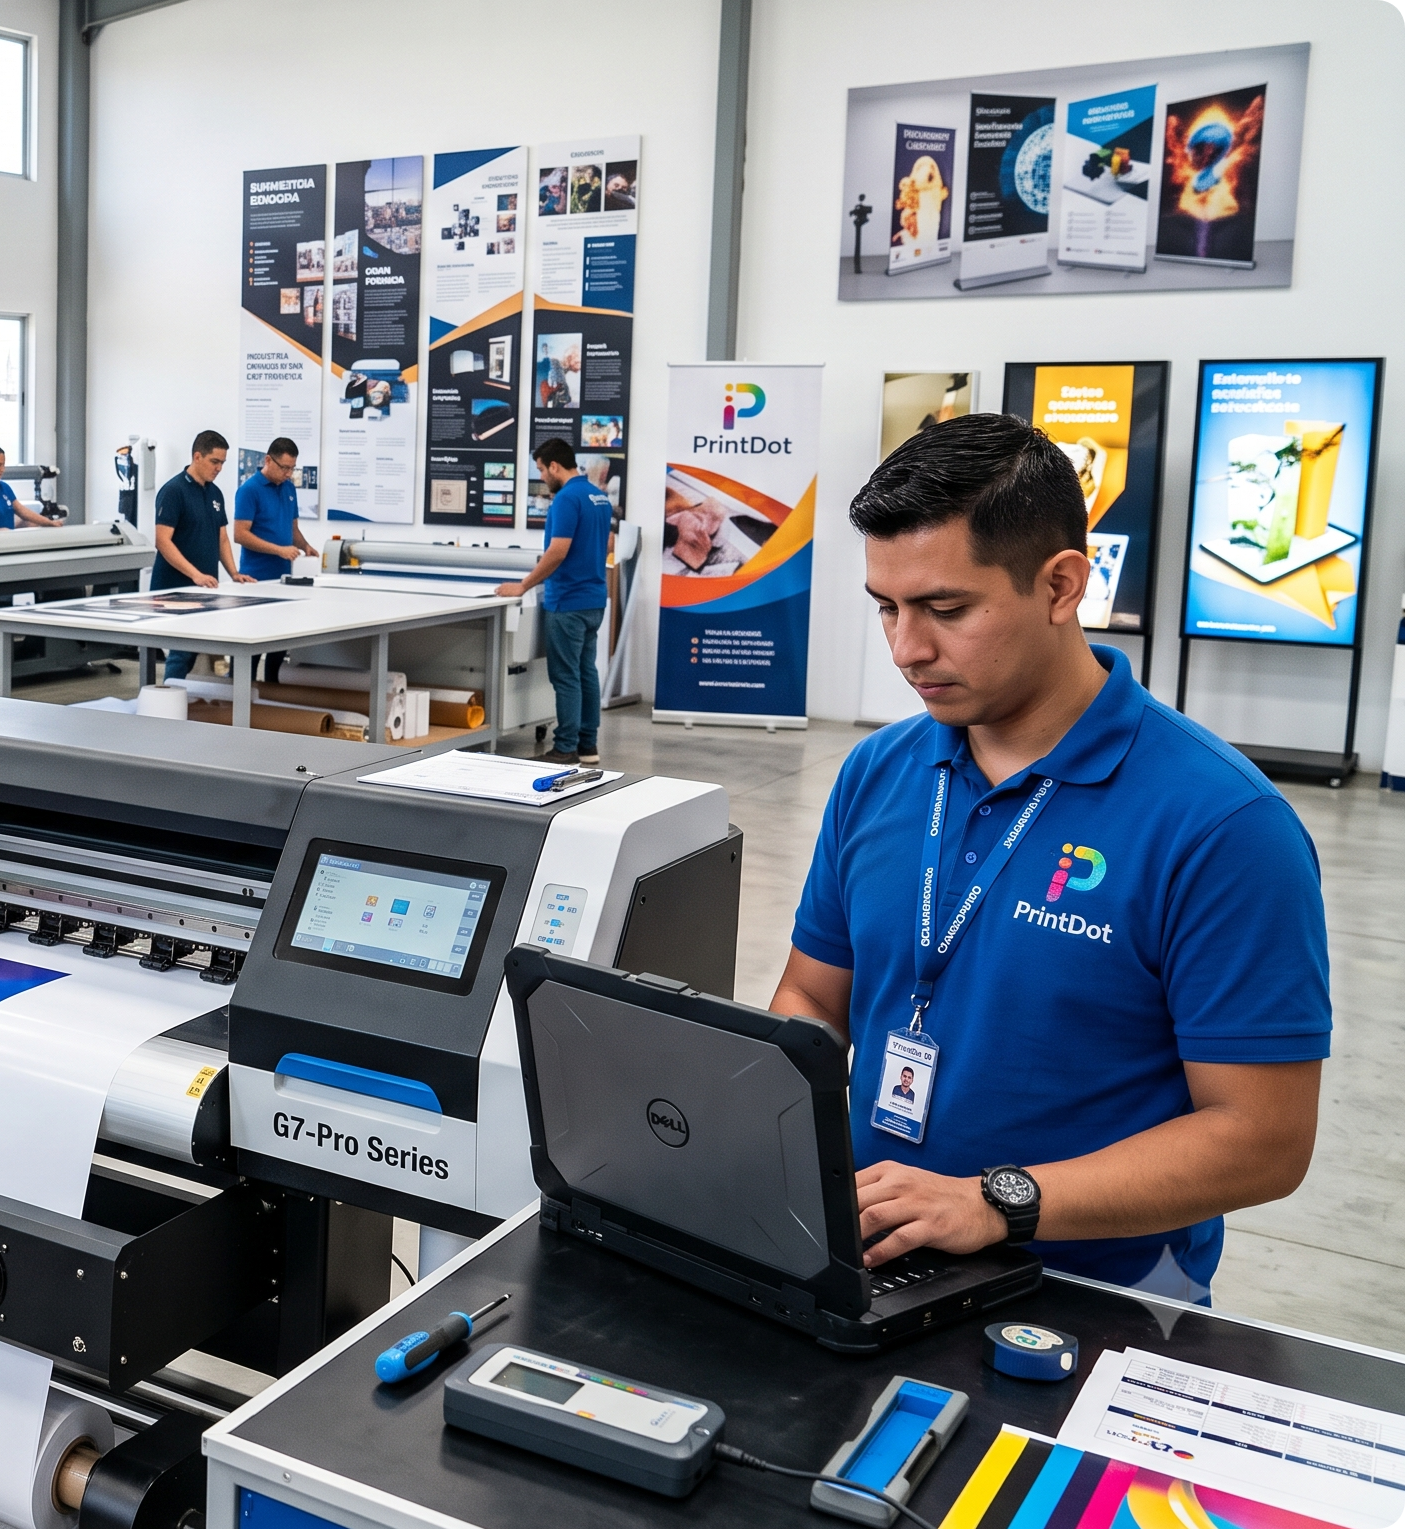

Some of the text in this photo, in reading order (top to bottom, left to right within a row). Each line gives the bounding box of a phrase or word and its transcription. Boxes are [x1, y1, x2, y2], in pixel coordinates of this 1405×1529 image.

[692, 436, 793, 455] PrintDot
[1012, 900, 1114, 945] PrintDot
[651, 1111, 686, 1134] DELL
[272, 1111, 450, 1180] G7-Pro Series
